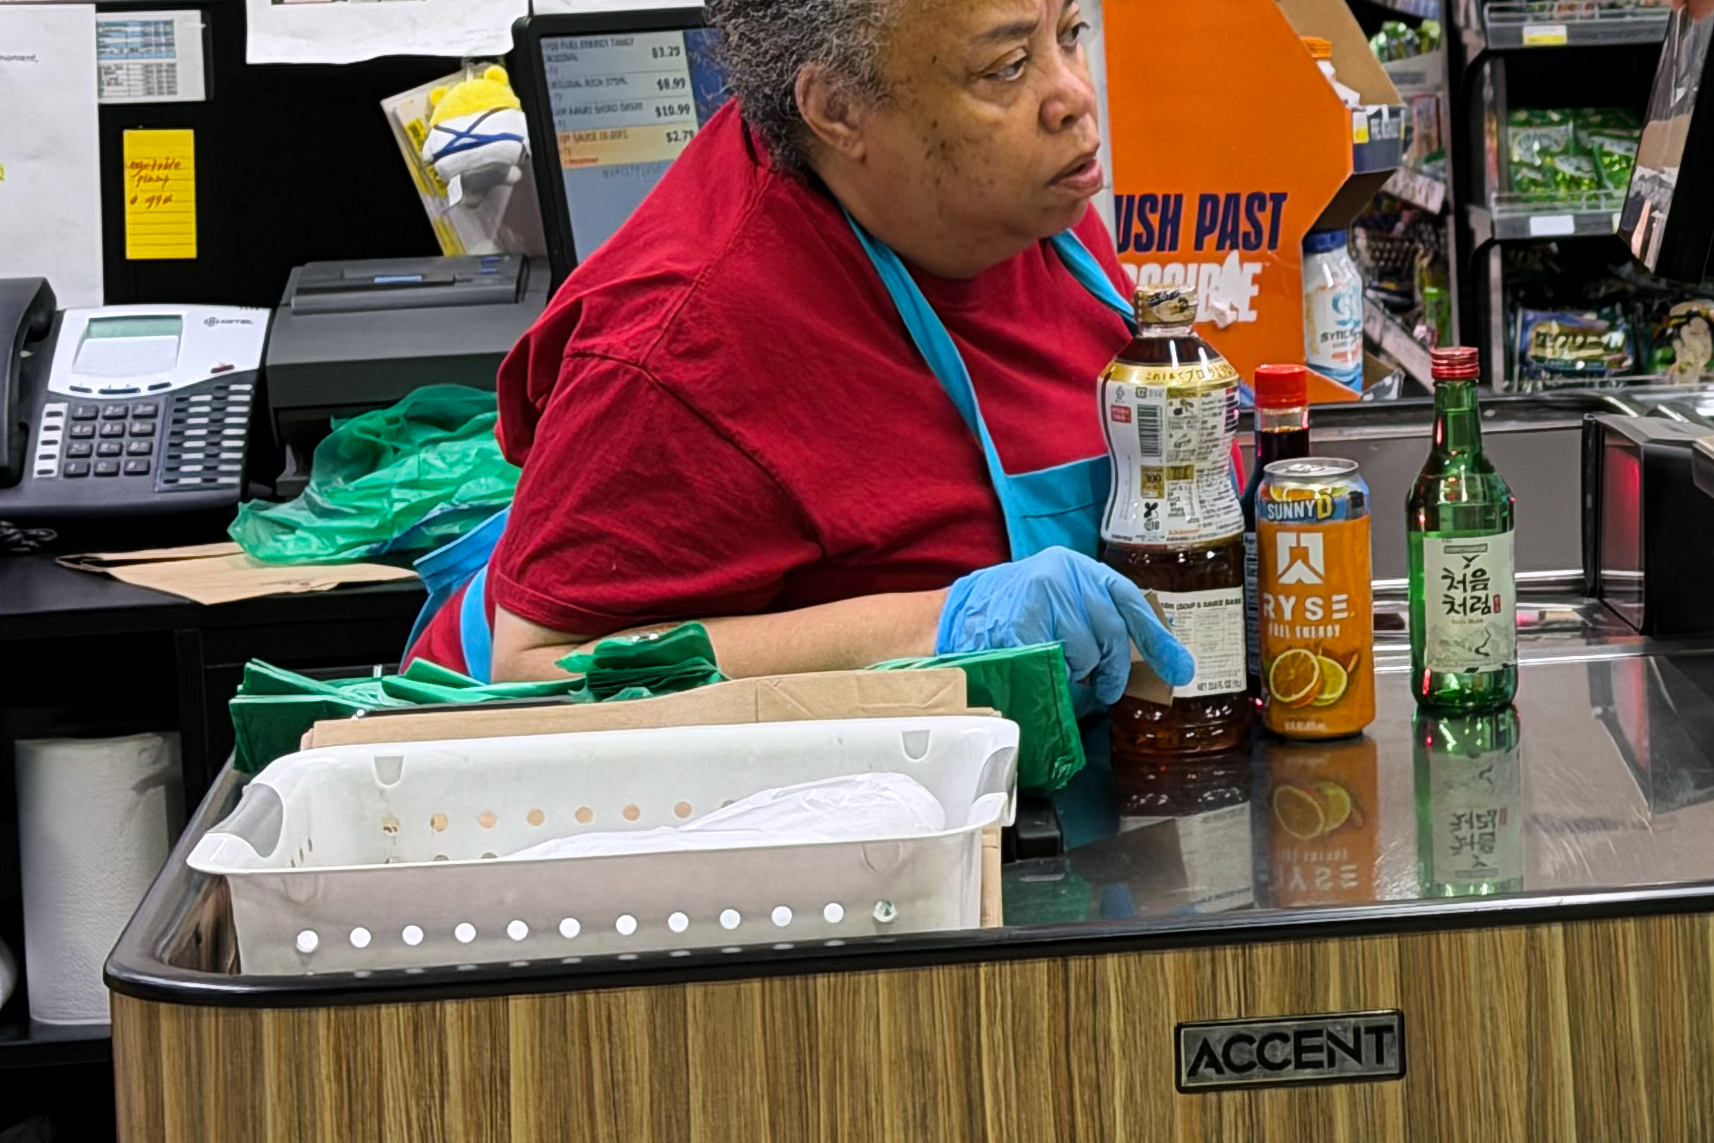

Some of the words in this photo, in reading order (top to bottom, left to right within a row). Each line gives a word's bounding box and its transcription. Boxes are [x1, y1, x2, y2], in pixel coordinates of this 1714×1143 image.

[655, 103, 691, 118] $10.99
[1114, 192, 1184, 253] USH
[1193, 191, 1289, 252] PAST
[1267, 494, 1333, 520] SUNNYD
[1441, 567, 1491, 593] 처음
[1263, 593, 1349, 621] RYSE
[1441, 593, 1492, 616] 처럼
[1187, 1025, 1395, 1079] ACCENT
